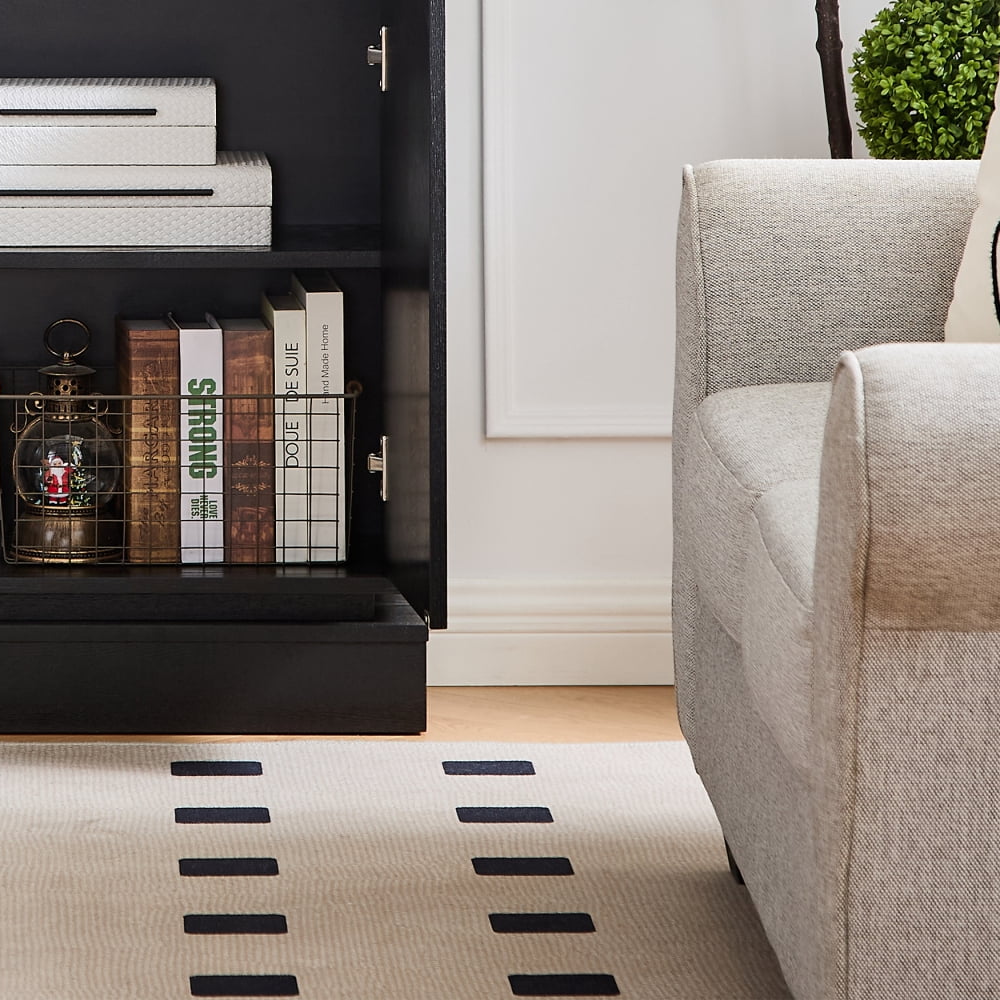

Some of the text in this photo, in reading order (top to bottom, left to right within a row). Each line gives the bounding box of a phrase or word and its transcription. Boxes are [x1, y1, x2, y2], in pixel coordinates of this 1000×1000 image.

[321, 324, 329, 351] Home
[285, 342, 298, 377] SUIE
[321, 353, 330, 377] Made
[285, 381, 299, 402] DE
[187, 378, 217, 479] STRONG
[191, 498, 200, 519] DIES.
[199, 494, 208, 519] NEVER
[208, 500, 218, 519] LOVE
